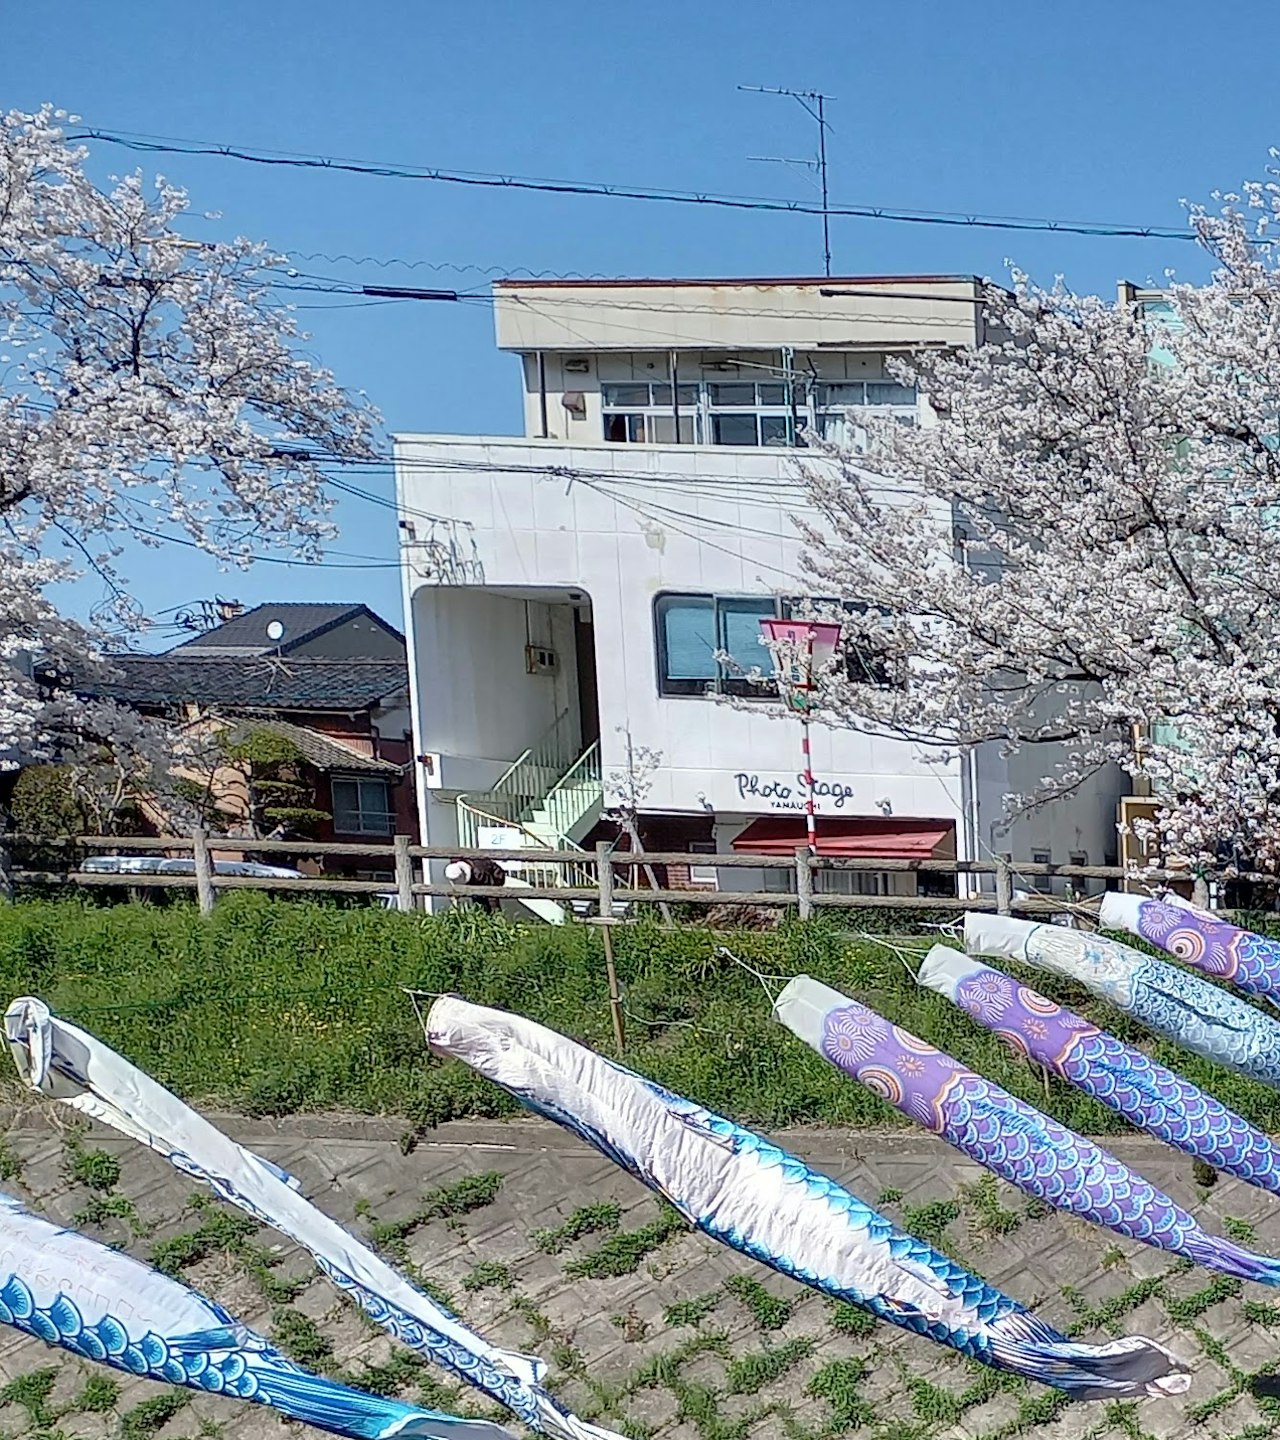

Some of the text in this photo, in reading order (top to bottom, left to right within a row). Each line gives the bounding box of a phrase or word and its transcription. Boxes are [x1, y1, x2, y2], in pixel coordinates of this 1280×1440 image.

[734, 773, 854, 808] Photo Stage
[491, 833, 508, 845] 2F
